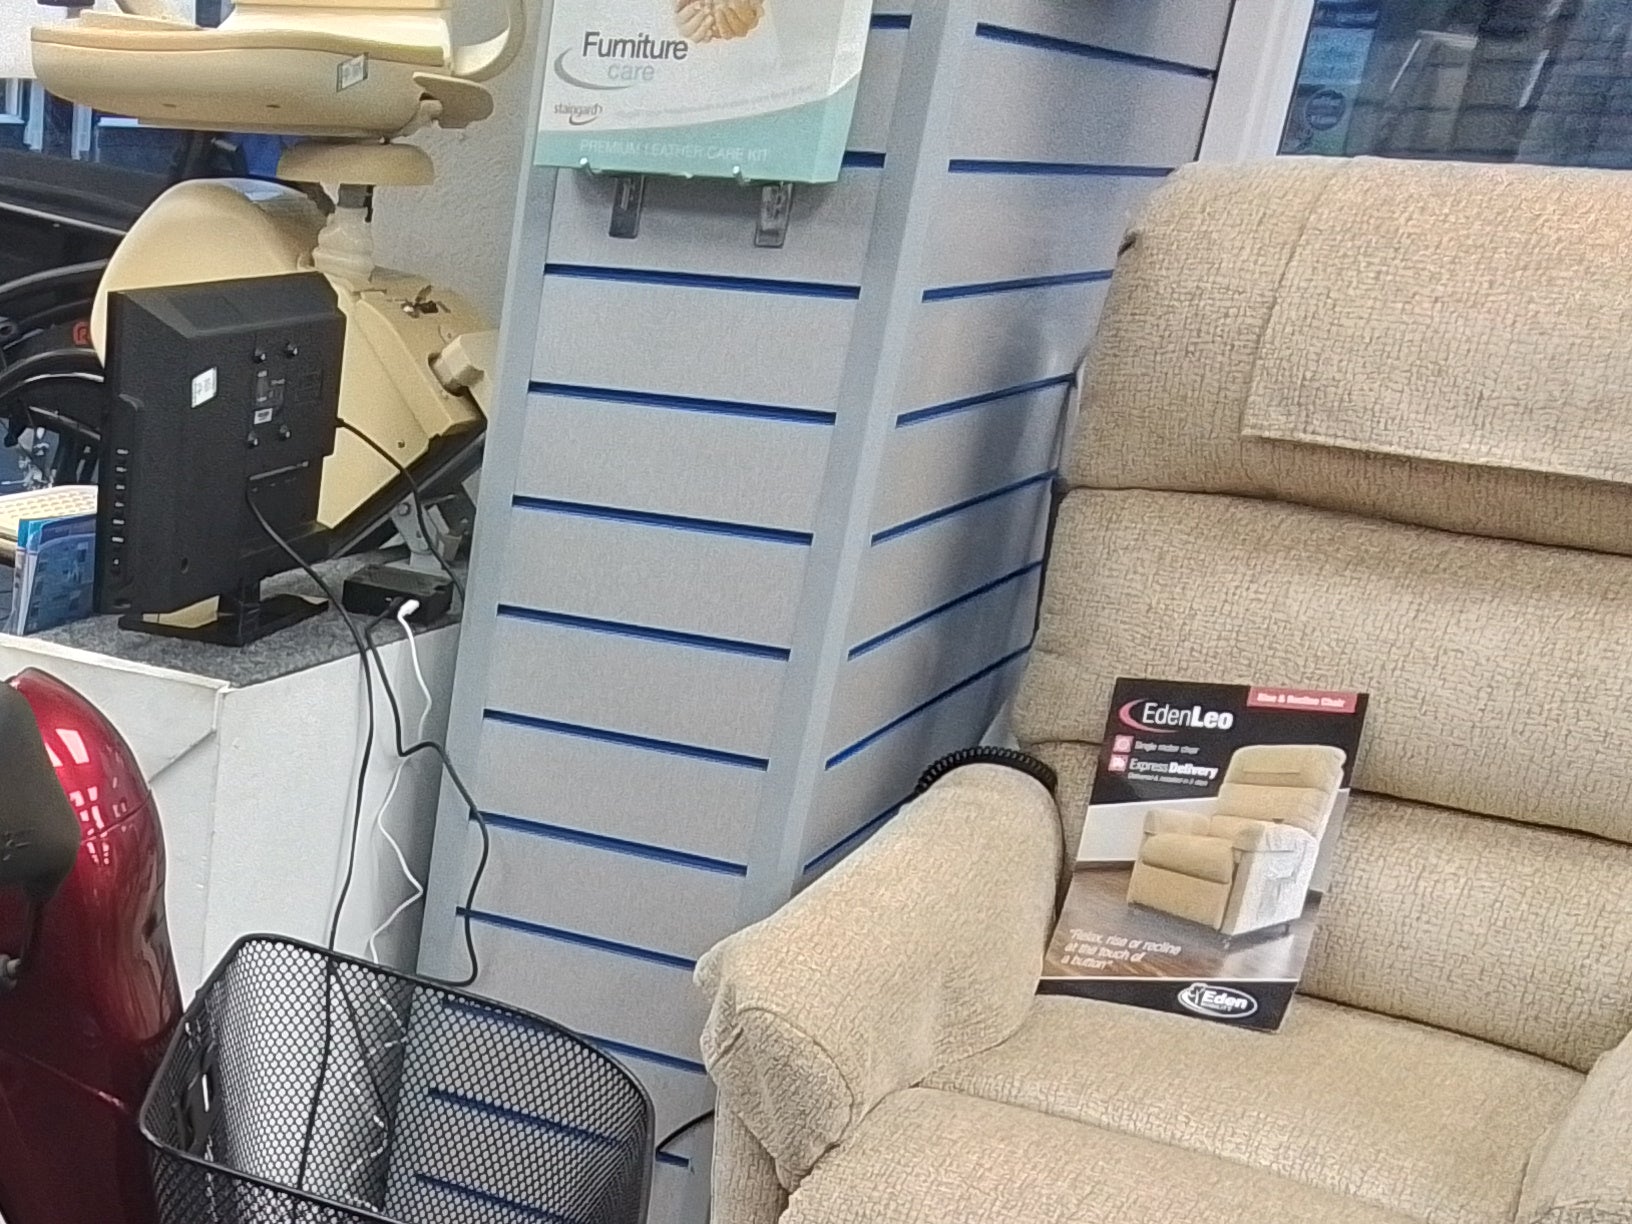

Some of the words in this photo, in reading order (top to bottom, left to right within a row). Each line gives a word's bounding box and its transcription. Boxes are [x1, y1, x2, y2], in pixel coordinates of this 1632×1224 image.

[582, 31, 689, 60] Furniture
[607, 63, 655, 81] care
[554, 102, 601, 119] staingard
[579, 138, 641, 155] PREMIUM
[643, 143, 704, 158] LEATHER
[707, 146, 744, 160] CARE
[748, 148, 768, 162] KIT
[1320, 697, 1346, 708] Chair
[1142, 702, 1234, 730] EdenLeo
[1064, 942, 1079, 952] at
[1078, 942, 1099, 956] the
[1098, 946, 1130, 961] touch
[1128, 939, 1144, 949] or
[1142, 940, 1182, 956] recline
[1060, 954, 1071, 964] a
[1202, 990, 1248, 1010] Eden
